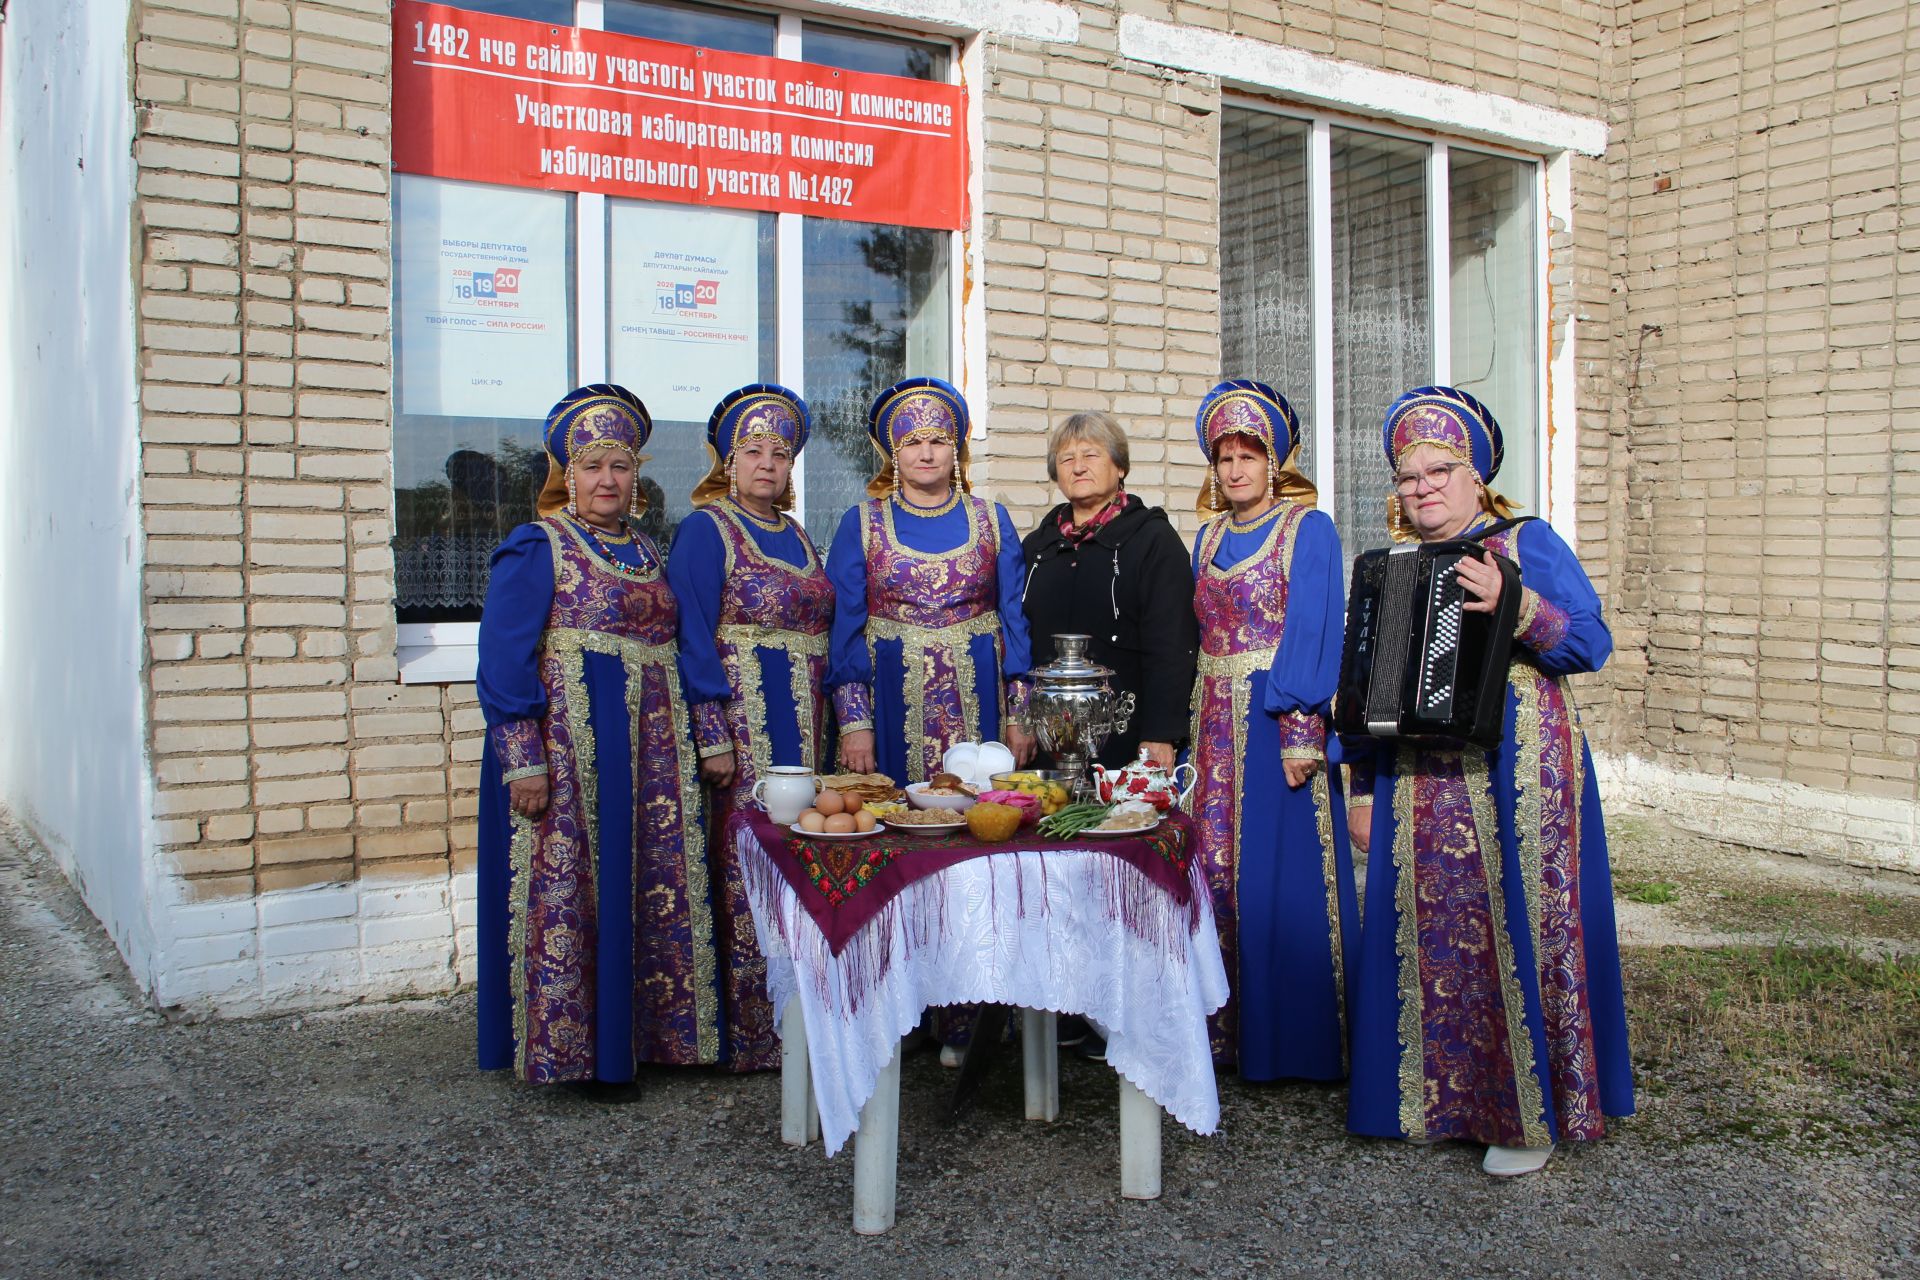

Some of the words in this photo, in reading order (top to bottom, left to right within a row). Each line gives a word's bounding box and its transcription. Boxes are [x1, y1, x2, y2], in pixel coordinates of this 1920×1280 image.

[413, 20, 470, 59] 1482
[479, 37, 517, 67] нче
[526, 43, 597, 81] сайлау
[605, 55, 695, 92] участогы
[703, 71, 777, 102] участок
[784, 80, 843, 116] сайлау
[850, 92, 951, 127] комиссиясе
[514, 93, 632, 137] Участковая
[641, 113, 782, 155] избирательная
[790, 134, 874, 167] комиссия
[540, 146, 698, 189] избирательного
[706, 167, 780, 198] участка
[788, 171, 854, 206] №1482
[442, 239, 479, 249] ВЫБОРЫ
[480, 242, 528, 253] ДЕПУТАТОВ
[440, 250, 508, 262] ГОСУДАРСТВЕННОЙ
[684, 254, 717, 264] ДУМАСЫ
[452, 269, 473, 277] 2026
[455, 285, 472, 299] 18
[475, 278, 493, 293] 19
[495, 273, 517, 288] 20
[656, 280, 675, 289] 2026
[658, 296, 675, 310] 18
[677, 290, 693, 304] 19
[696, 285, 716, 300] 20
[477, 299, 519, 309] СЕНТЯБРЯ
[679, 310, 718, 320] СЕНТЯБРЬ
[425, 315, 448, 325] ТВОЙ
[449, 317, 478, 327] ГОЛОС
[486, 320, 509, 329] СИЛА
[510, 323, 546, 331] РОССИИ!
[649, 327, 676, 336] ТАВЫШ
[471, 377, 503, 386] ЦИК.РФ
[672, 384, 701, 393] ЦИК.РФ
[1358, 597, 1372, 652] ТУЛА
